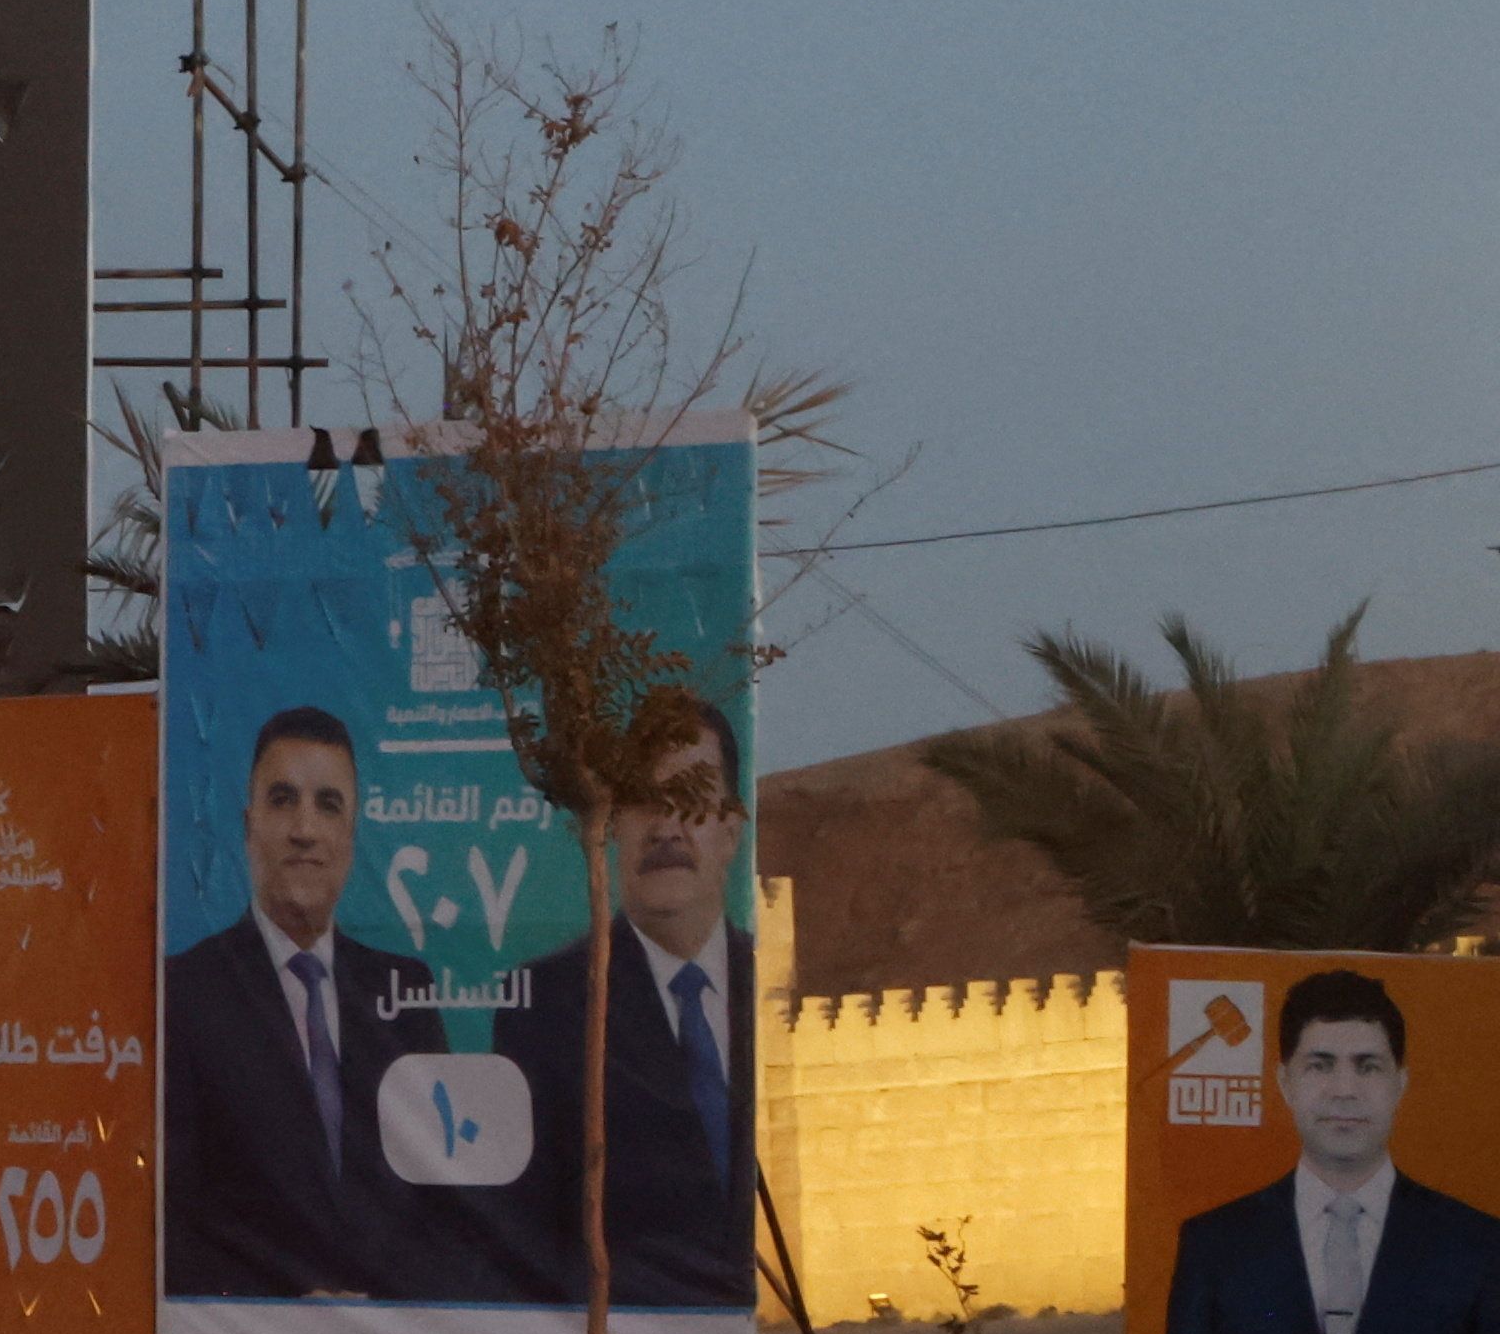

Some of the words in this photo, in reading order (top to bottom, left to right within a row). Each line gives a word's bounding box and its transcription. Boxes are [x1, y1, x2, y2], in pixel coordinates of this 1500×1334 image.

[364, 782, 481, 823] القائمة
[488, 784, 552, 830] رقم
[386, 847, 528, 952] ٢٠٧
[375, 970, 533, 1021] التسلسل
[45, 1009, 143, 1083] مرفت
[432, 1081, 480, 1158] ١٠
